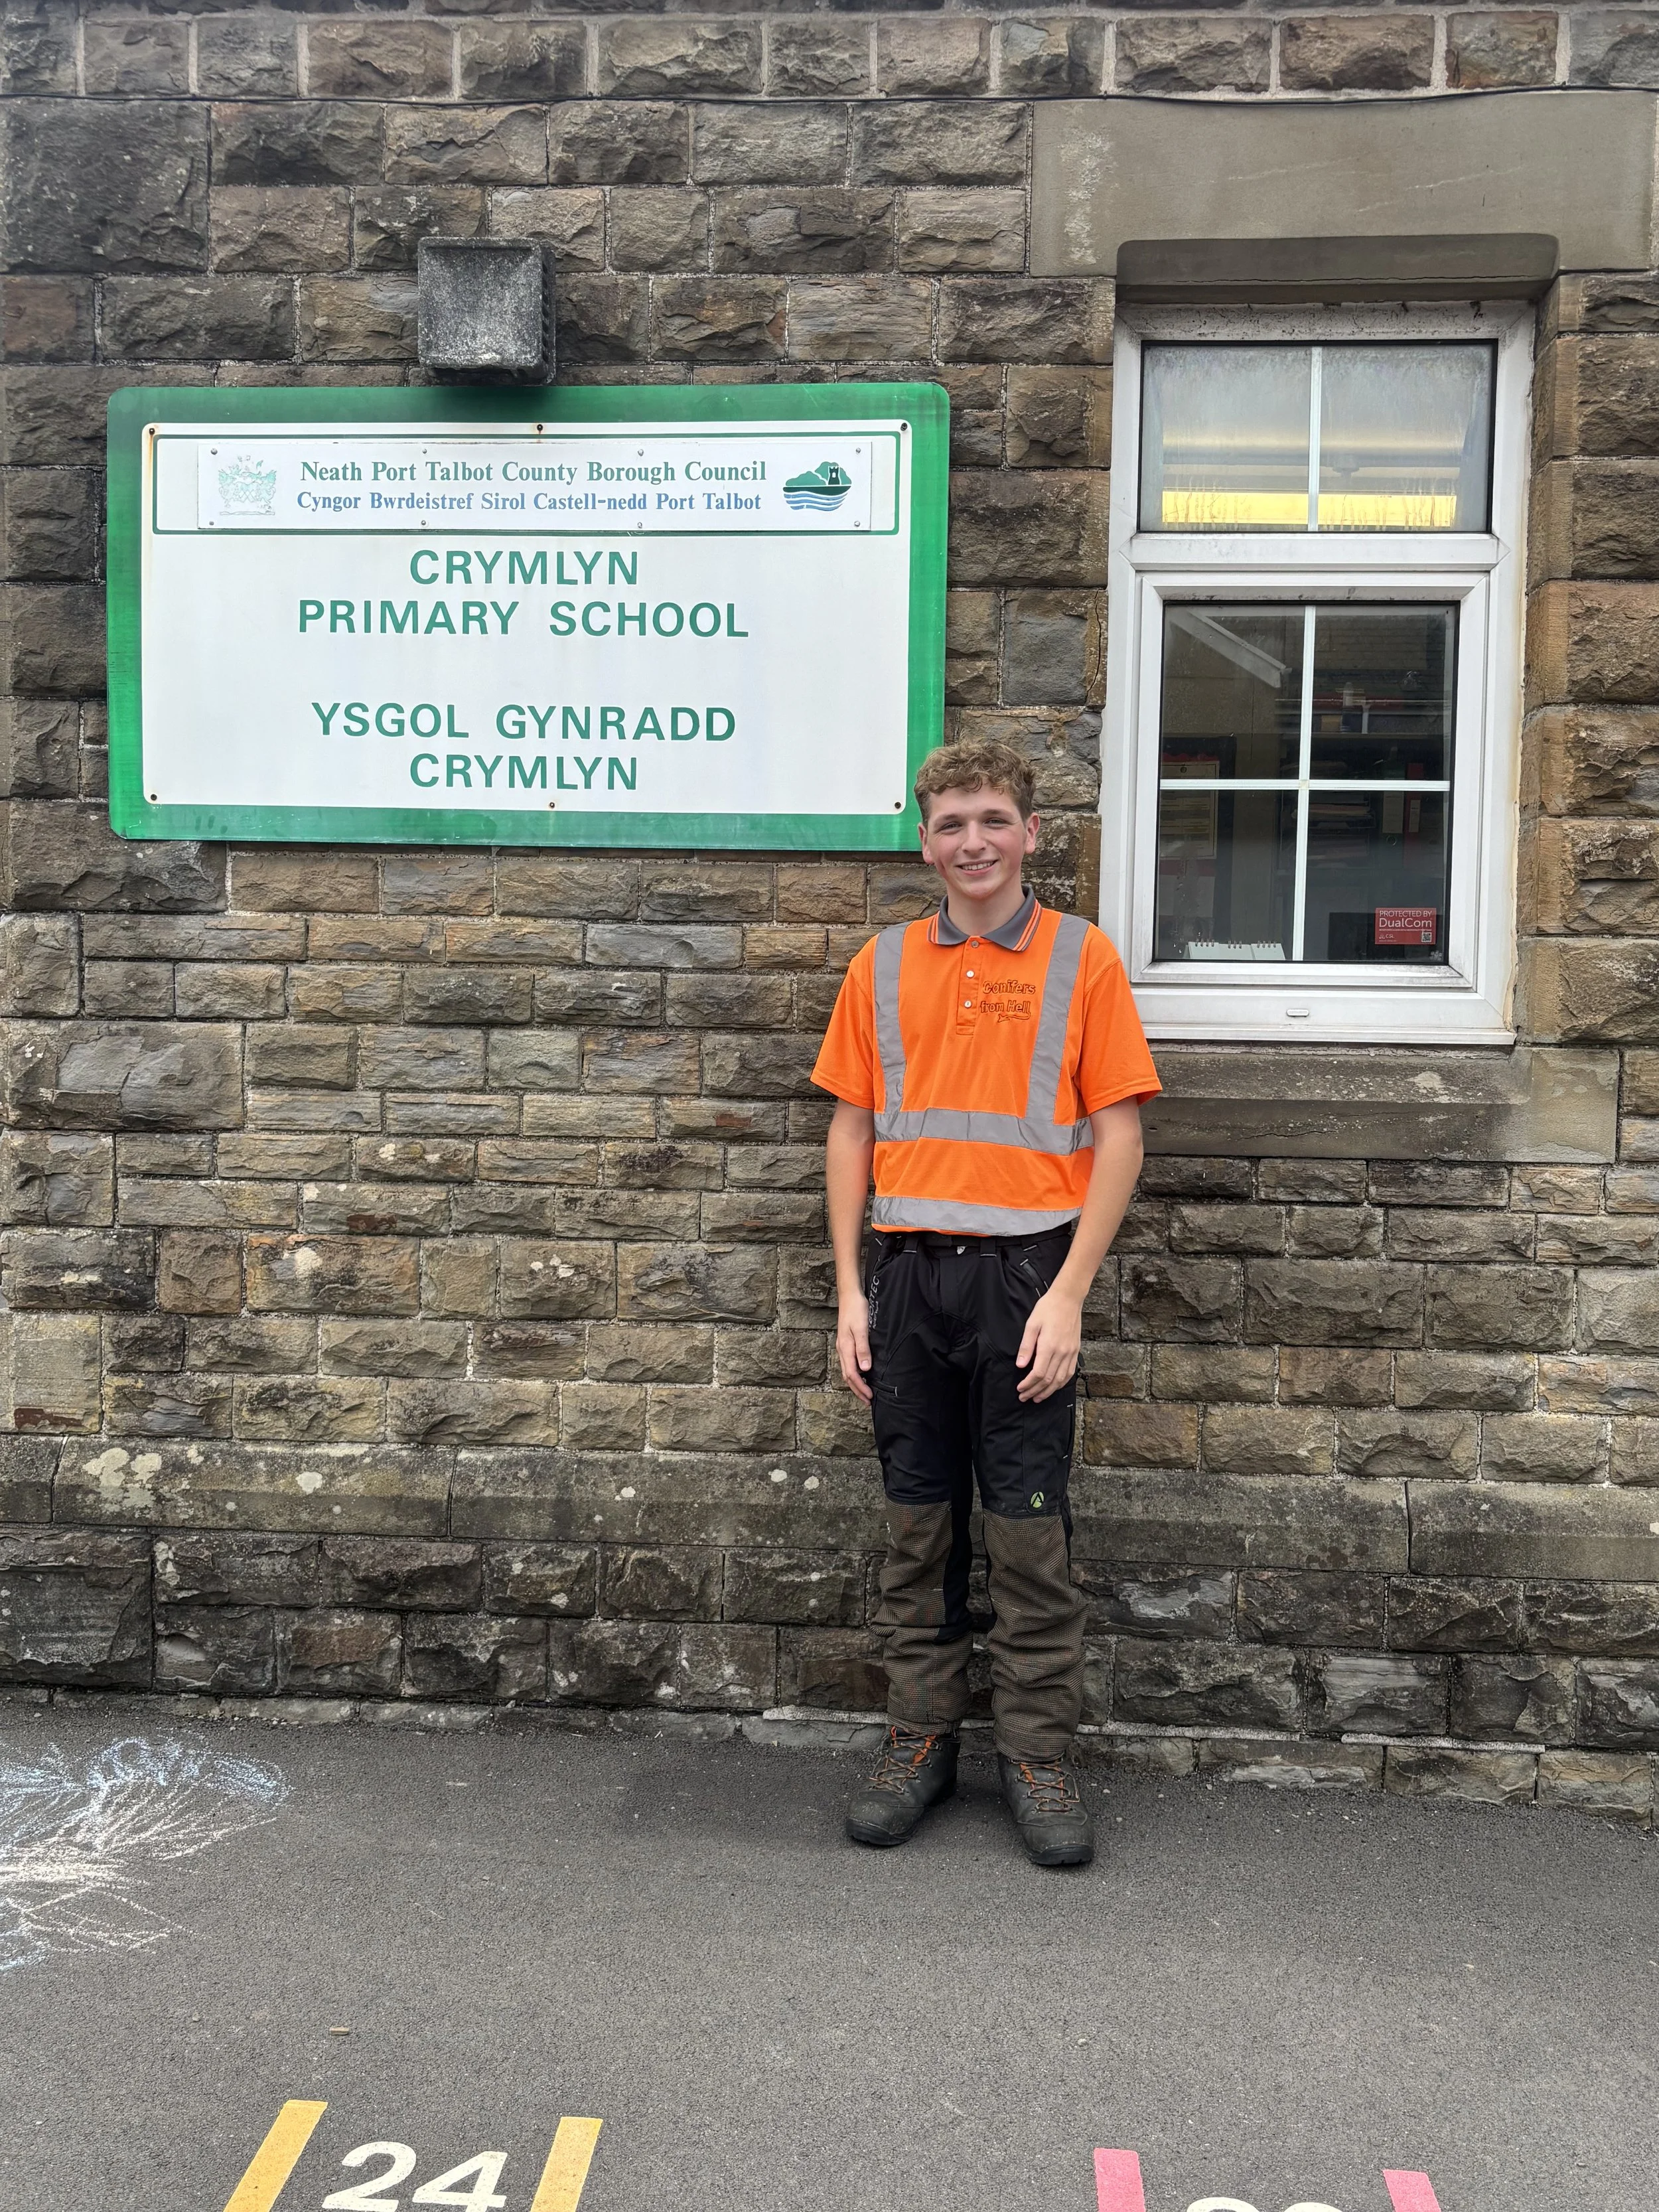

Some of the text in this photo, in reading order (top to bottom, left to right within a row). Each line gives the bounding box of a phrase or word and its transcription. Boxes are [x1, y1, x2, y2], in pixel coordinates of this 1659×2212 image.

[301, 461, 766, 485] Neath Port Talbot County Borough Council
[297, 492, 761, 512] Cyngor Bwrdeistref Sirol Castell-nedd Port Talbot
[410, 550, 638, 585] CRYMLYN
[299, 600, 749, 637] PRIMARY SCHOOL
[312, 703, 735, 741] YSGOL GYNRADD
[410, 753, 637, 790] CRYMLYN
[1379, 918, 1432, 928] DualCom
[983, 980, 1036, 994] Conifers
[980, 999, 1031, 1013] from Hell
[322, 2141, 508, 2212] 24
